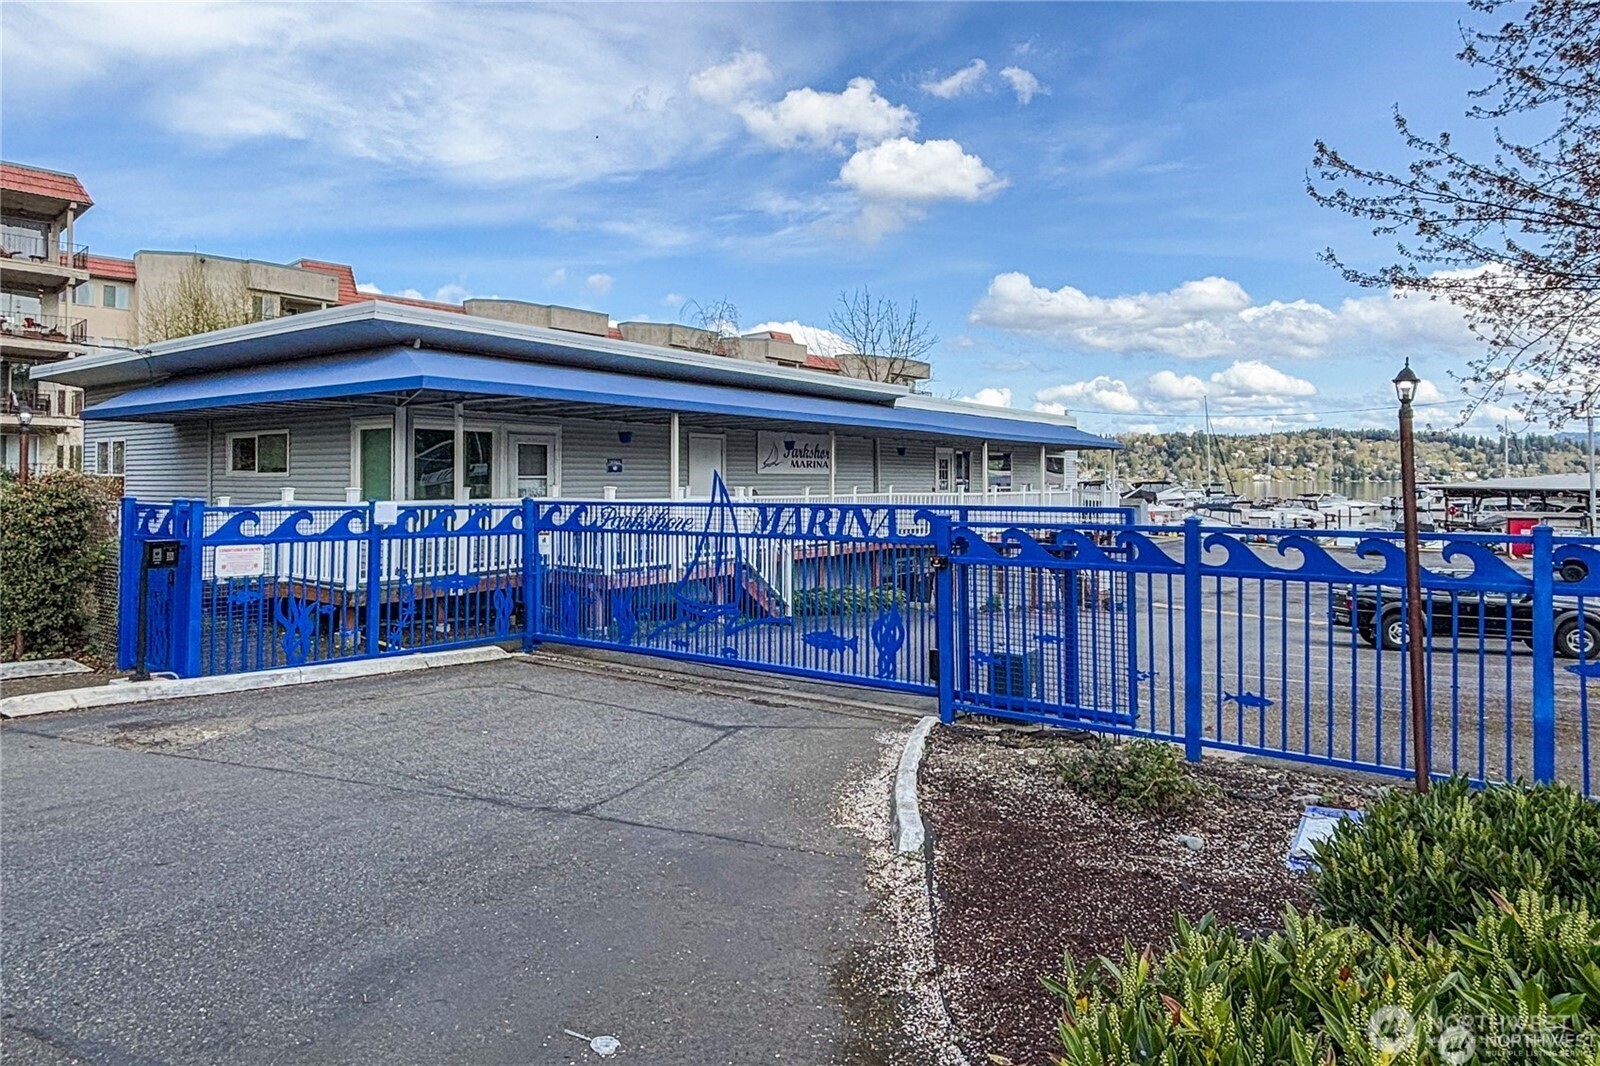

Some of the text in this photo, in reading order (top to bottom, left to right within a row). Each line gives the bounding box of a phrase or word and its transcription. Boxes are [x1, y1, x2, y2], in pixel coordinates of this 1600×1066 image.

[783, 443, 830, 460] arkshor
[790, 460, 829, 469] MARINA
[750, 506, 897, 537] MARINA
